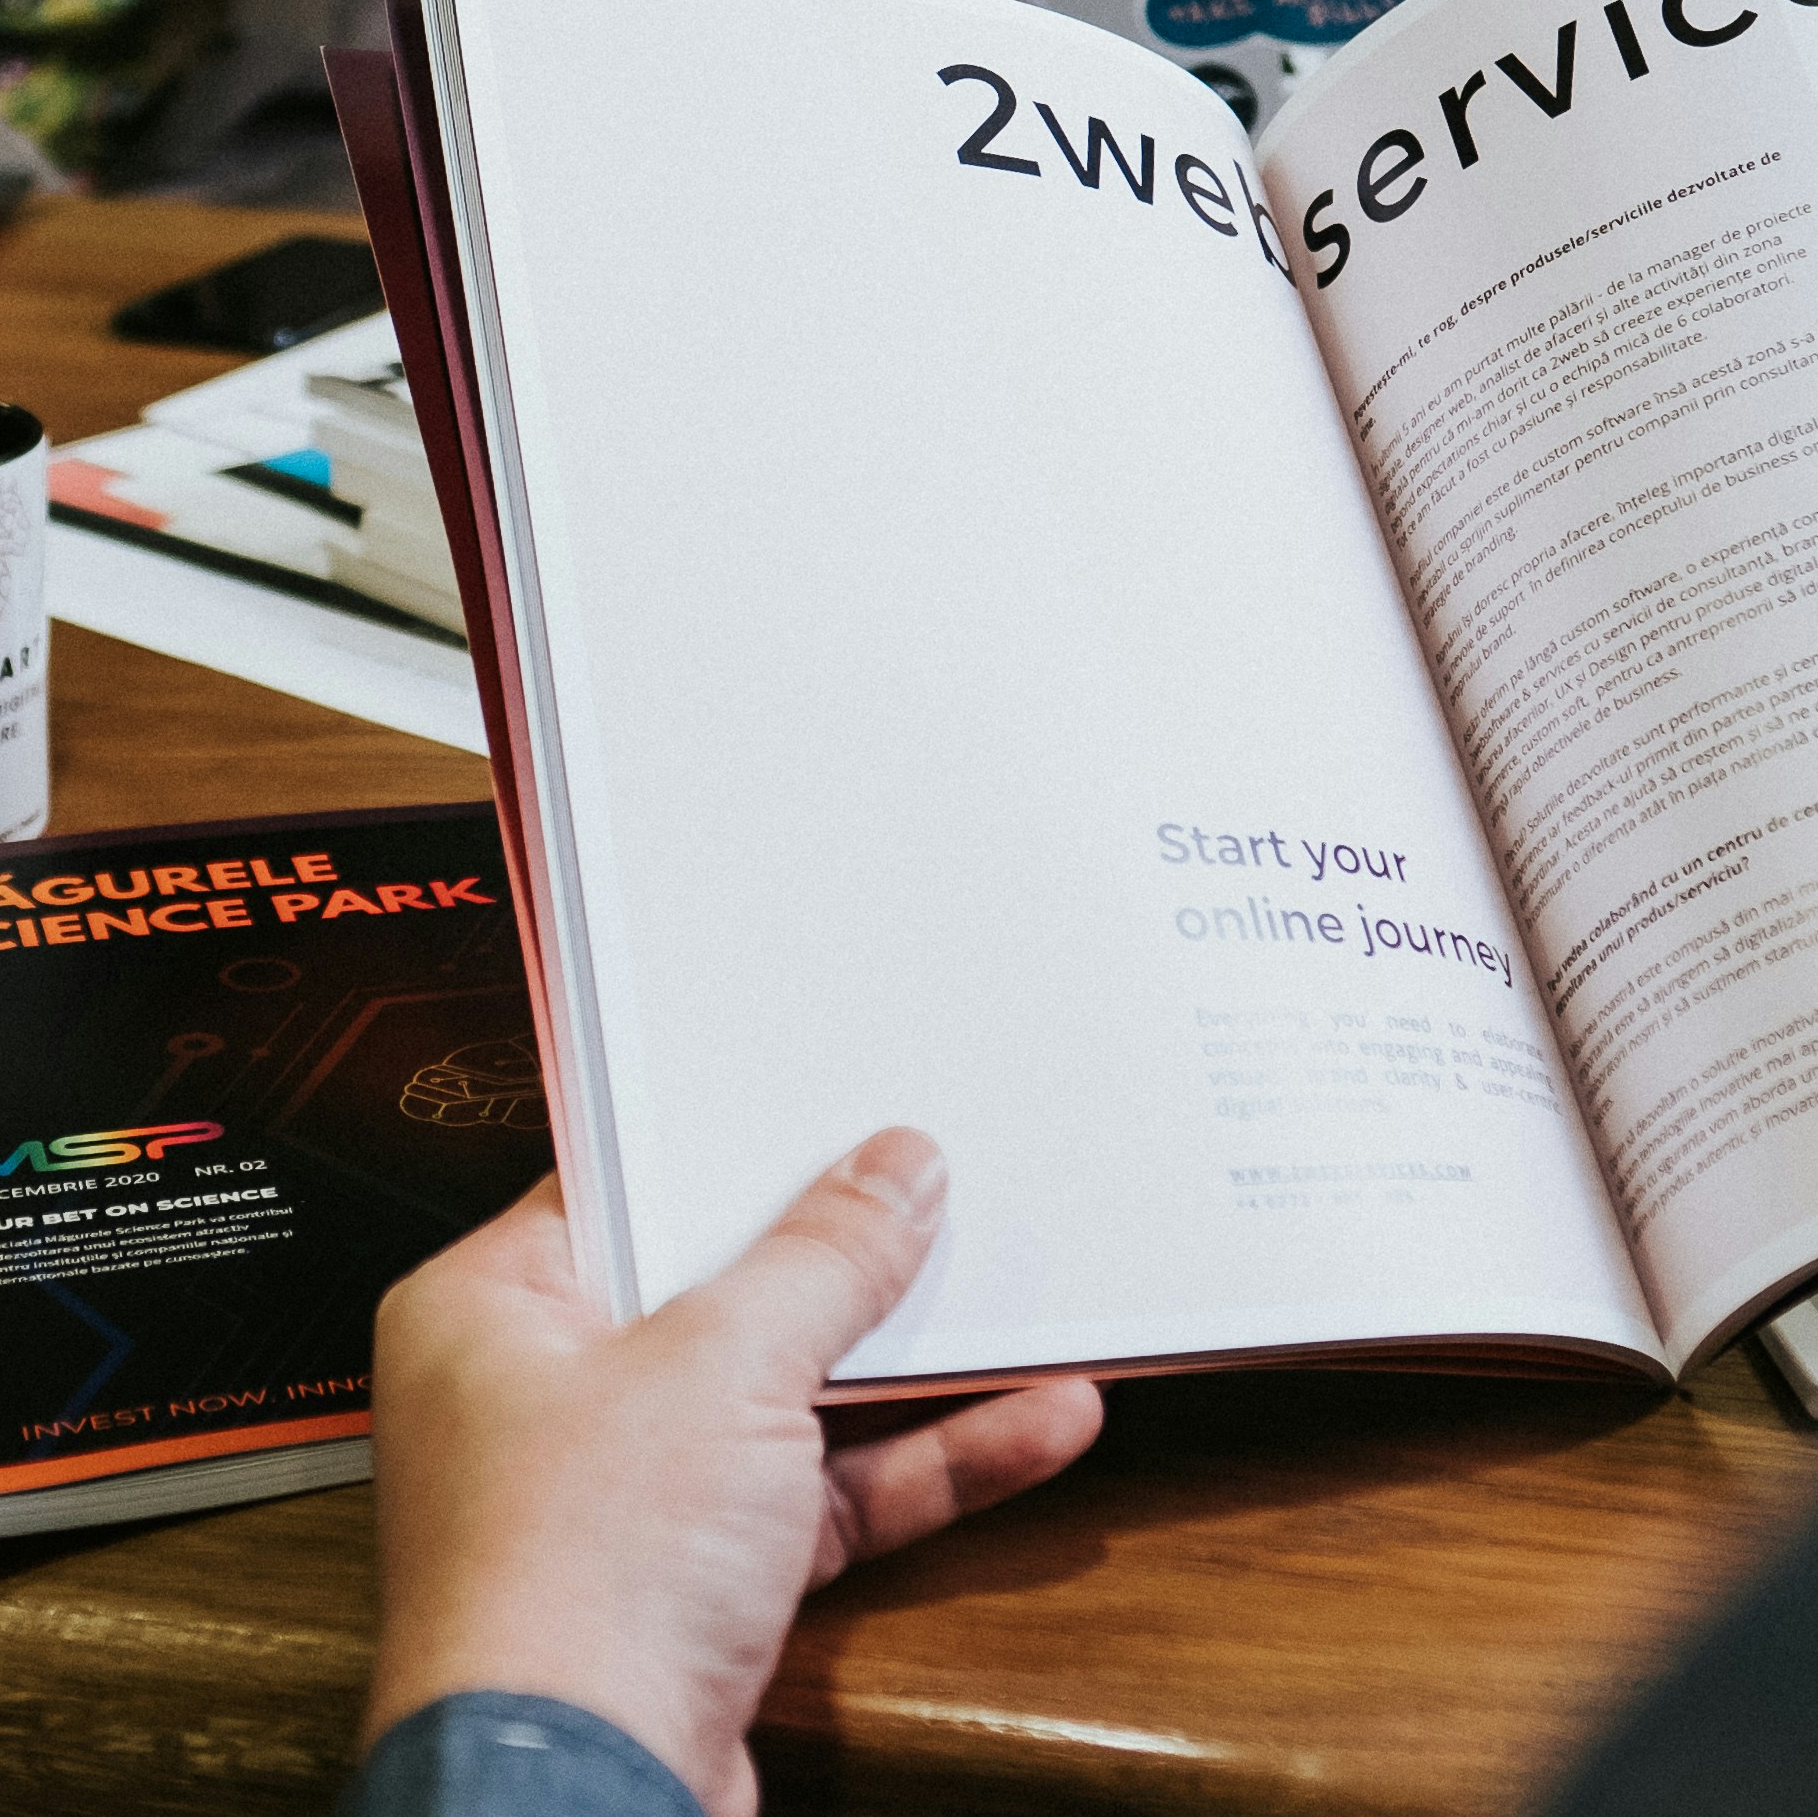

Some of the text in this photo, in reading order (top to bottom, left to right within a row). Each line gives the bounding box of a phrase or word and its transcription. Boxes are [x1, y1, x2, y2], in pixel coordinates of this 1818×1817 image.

[936, 64, 1297, 289] 2web
[1418, 333, 1430, 347] te
[1460, 280, 1506, 316] despre
[1510, 199, 1662, 286] produsele/serviciile
[1666, 161, 1755, 202] dezvoltate
[1760, 151, 1780, 165] de
[1410, 405, 1426, 428] ani
[1427, 393, 1441, 411] eu
[1444, 377, 1462, 397] am
[1464, 347, 1504, 384] purtat
[1505, 322, 1545, 352] multe
[1606, 280, 1625, 295] de
[1627, 271, 1643, 284] la
[1646, 239, 1715, 275] manager
[1721, 230, 1740, 244] de
[1745, 203, 1811, 238] proiecte
[1405, 412, 1444, 458] designer
[1479, 359, 1521, 393] analist
[1523, 347, 1540, 363] de
[1544, 316, 1592, 351] afaceri
[1613, 294, 1639, 314] alte
[1713, 252, 1739, 269] din
[1742, 235, 1782, 257] zona
[1408, 442, 1440, 482] pentru
[1456, 399, 1494, 434] mi-am
[1497, 375, 1529, 403] dorit
[1531, 366, 1547, 380] ca
[1549, 341, 1589, 370] 2web
[1592, 329, 1609, 346] să
[1613, 306, 1662, 335] creeze
[1756, 248, 1807, 273] online
[1156, 822, 1407, 883] Start your
[1661, 871, 1679, 888] cu
[1680, 857, 1703, 875] un
[1706, 828, 1762, 861] centru
[1766, 816, 1788, 832] de
[280, 876, 496, 925] PARK
[1175, 896, 1514, 989] online journey
[1332, 1011, 1366, 1032] you
[1386, 1014, 1432, 1033] need
[1452, 1048, 1483, 1067] and
[104, 1171, 159, 1187] 2020
[194, 1164, 233, 1177] NR.
[239, 1159, 267, 1171] 02
[41, 1208, 97, 1224] BET
[105, 1202, 148, 1216] ON
[156, 1186, 278, 1210] SCIENCE
[115, 1223, 170, 1234] Science
[174, 1217, 205, 1227] Park
[119, 1231, 191, 1245] ecosistem
[22, 1405, 155, 1441] INVEST
